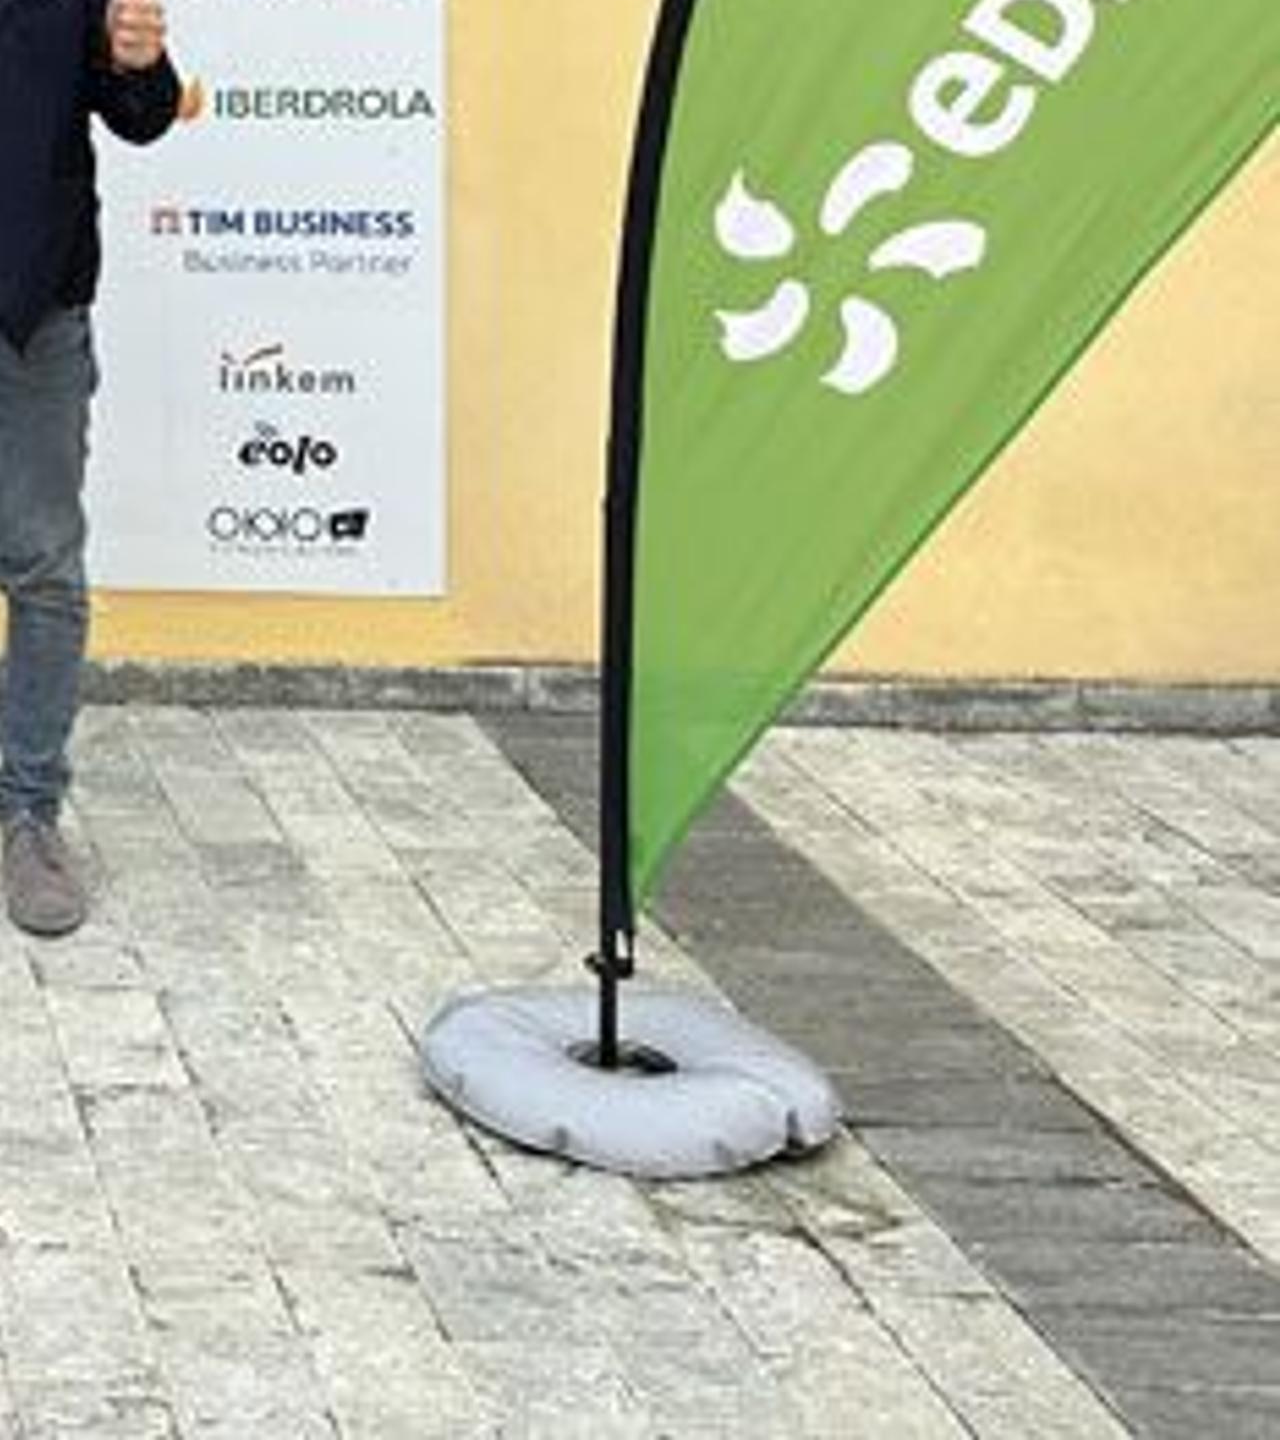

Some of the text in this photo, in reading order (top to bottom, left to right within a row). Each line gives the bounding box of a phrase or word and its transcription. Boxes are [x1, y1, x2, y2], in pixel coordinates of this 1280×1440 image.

[215, 90, 436, 119] IBERDROLA
[186, 210, 416, 238] TIM BUSINESS
[183, 250, 414, 274] Business Partner
[219, 354, 356, 394] linkem
